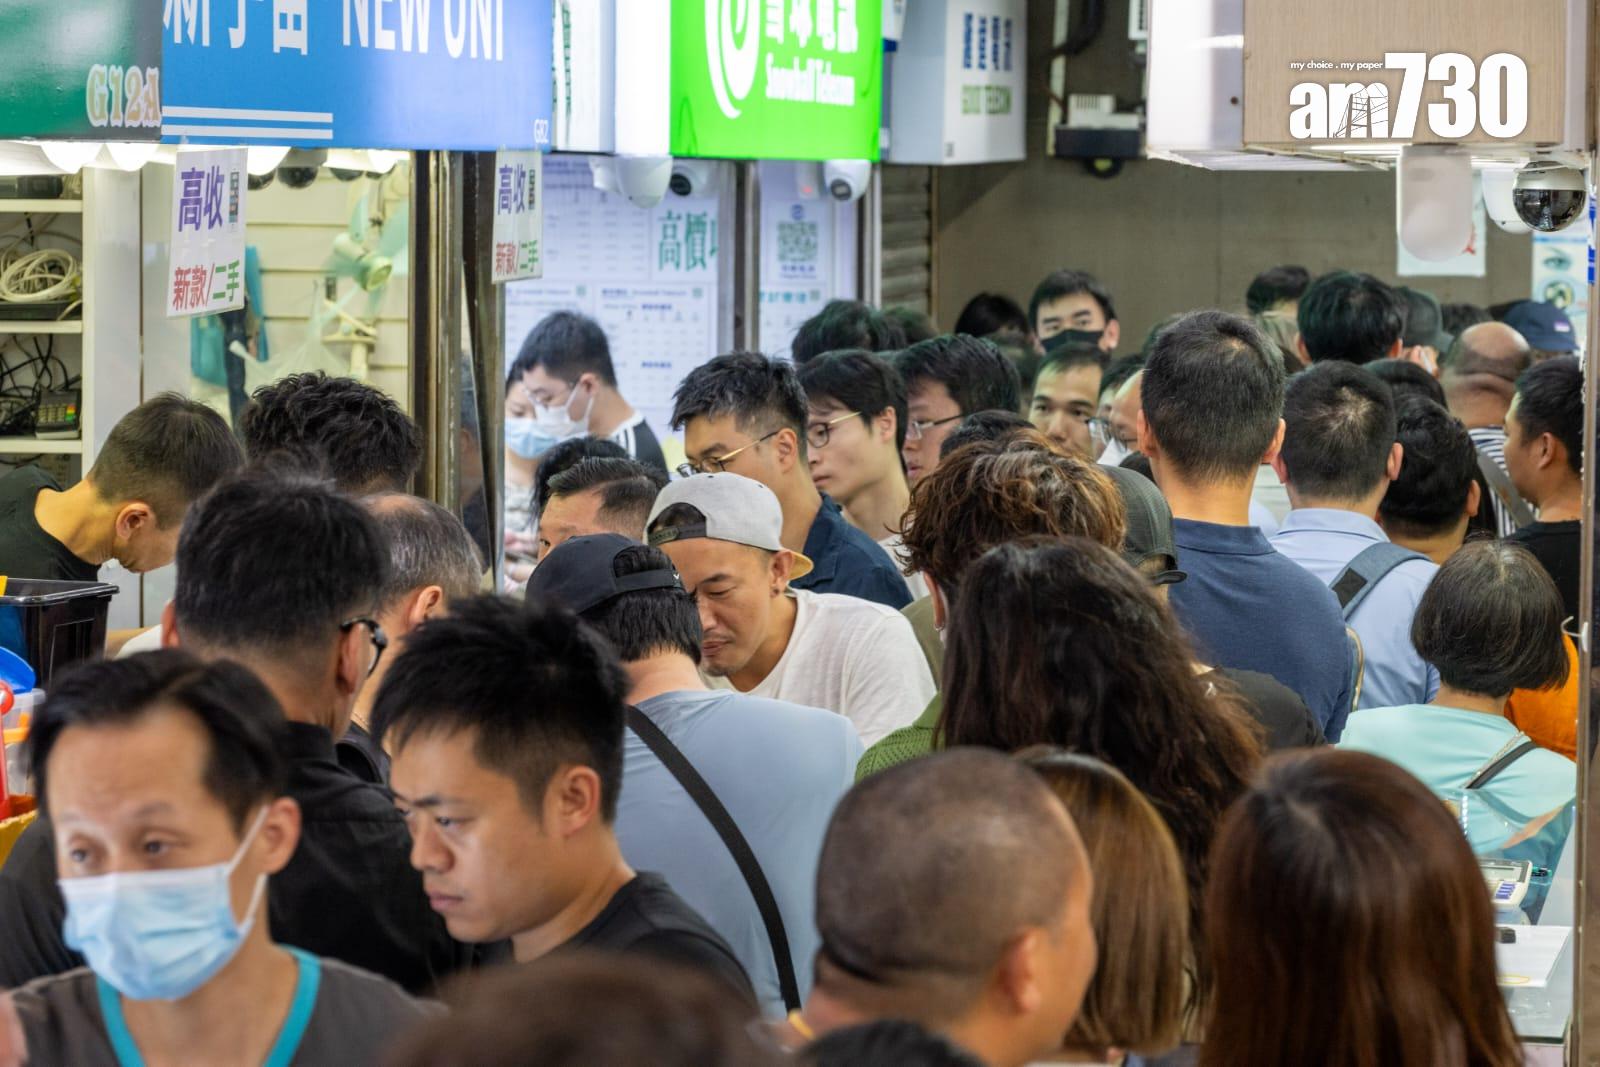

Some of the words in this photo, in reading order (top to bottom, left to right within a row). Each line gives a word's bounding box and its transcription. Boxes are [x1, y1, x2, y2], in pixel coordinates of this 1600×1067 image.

[86, 63, 162, 128] G12A
[178, 165, 225, 233] 高收
[497, 163, 527, 215] 高收
